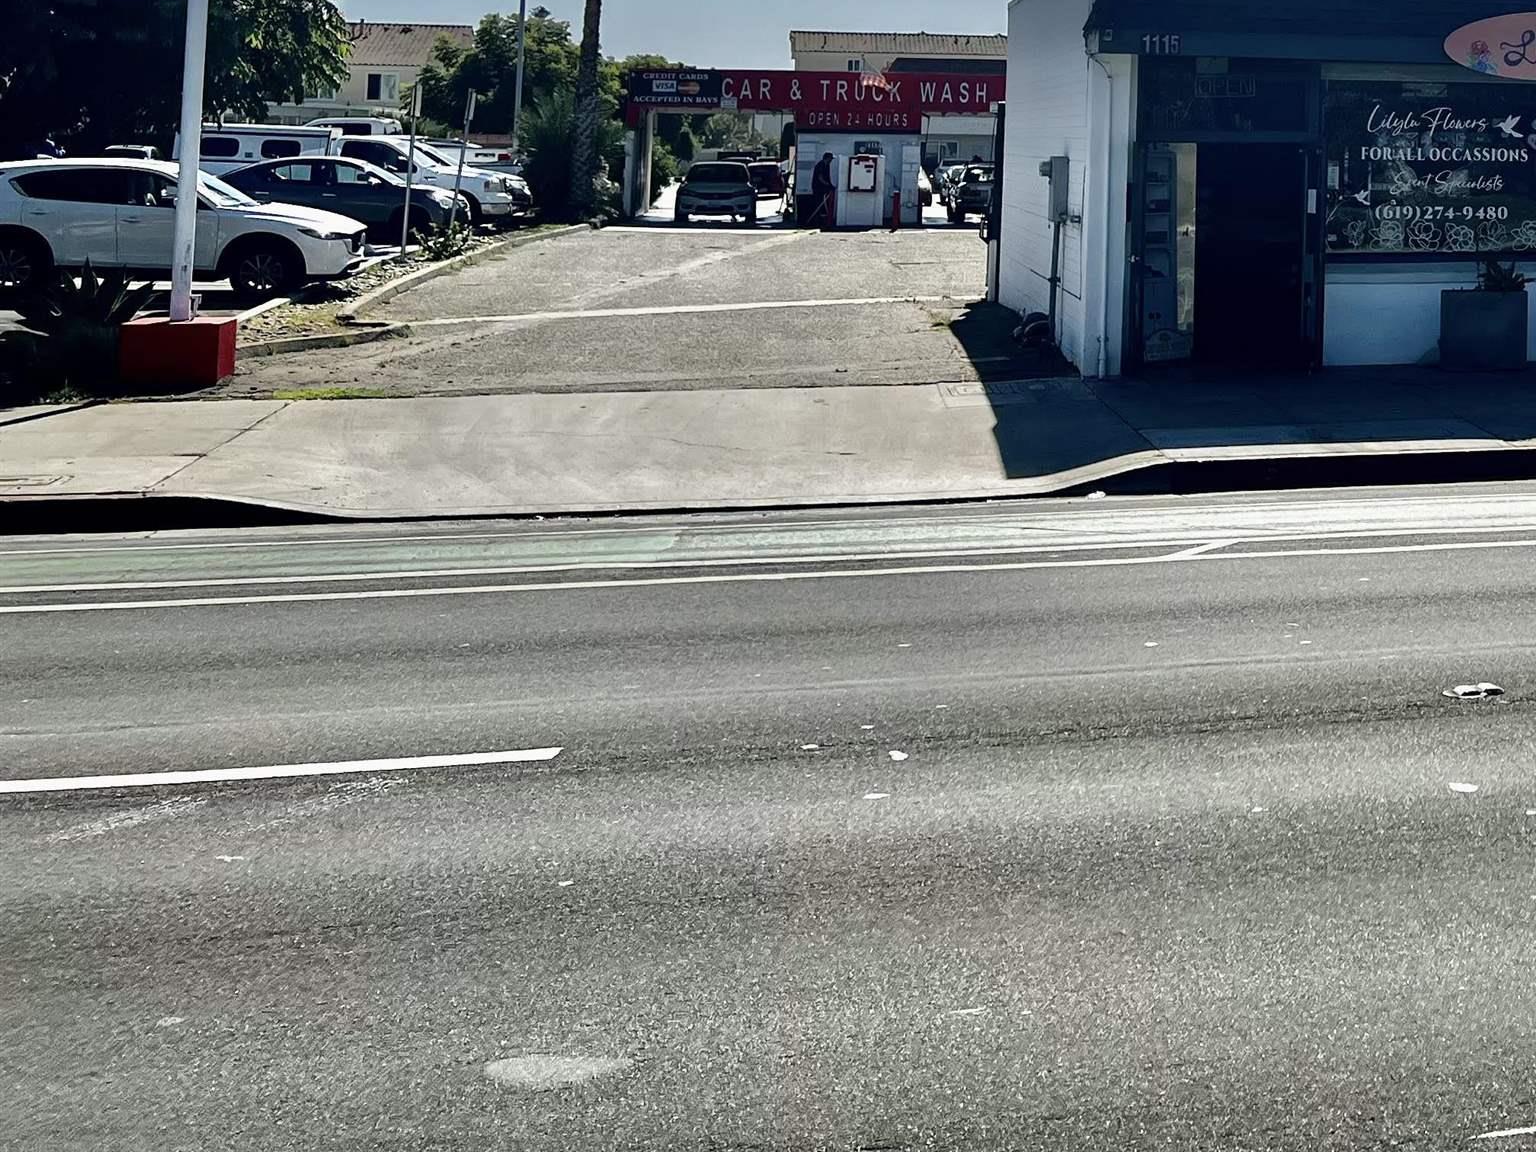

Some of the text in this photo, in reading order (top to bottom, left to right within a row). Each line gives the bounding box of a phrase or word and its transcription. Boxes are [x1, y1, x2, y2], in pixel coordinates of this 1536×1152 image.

[1142, 34, 1181, 55] 1115
[655, 80, 676, 89] VISA
[721, 78, 987, 103] CAR & TRUCK WASH
[1198, 79, 1254, 95] OPEN
[633, 95, 680, 103] ACCEPTED
[809, 112, 908, 127] OPEN 24 HOURS
[1367, 105, 1488, 136] Lilylu Flowers
[1361, 147, 1528, 162] FOR ALL OCCASSIONS
[1375, 206, 1508, 221] (619)274-9480
